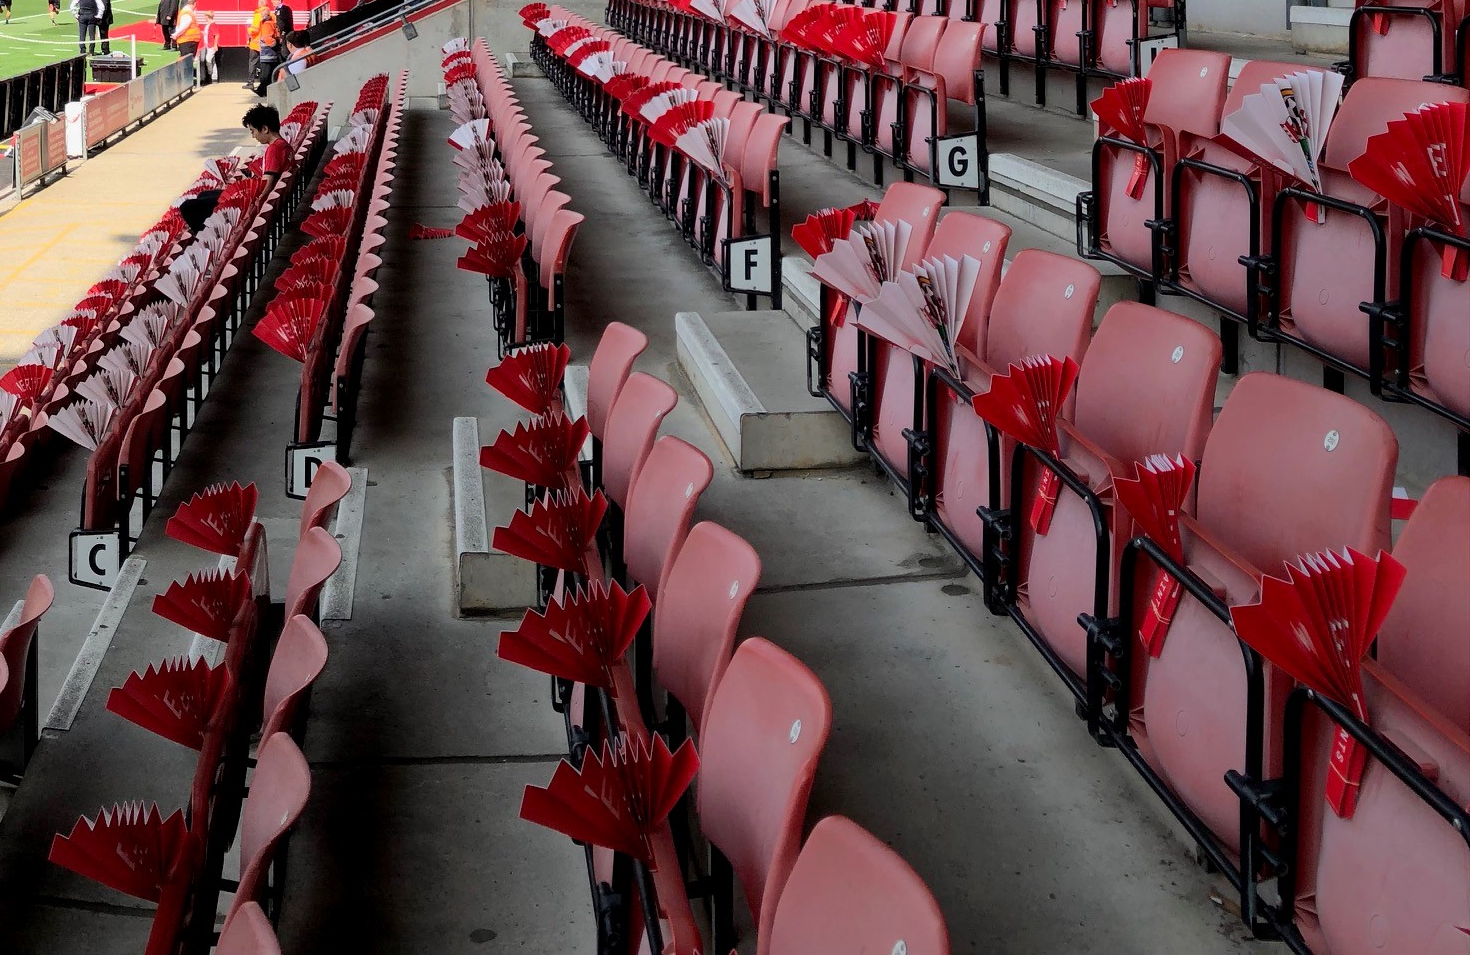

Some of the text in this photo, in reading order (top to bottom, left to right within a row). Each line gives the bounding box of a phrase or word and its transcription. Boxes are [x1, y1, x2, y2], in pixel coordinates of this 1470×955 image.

[946, 145, 970, 178] G
[742, 249, 762, 280] F
[88, 543, 107, 576] C
